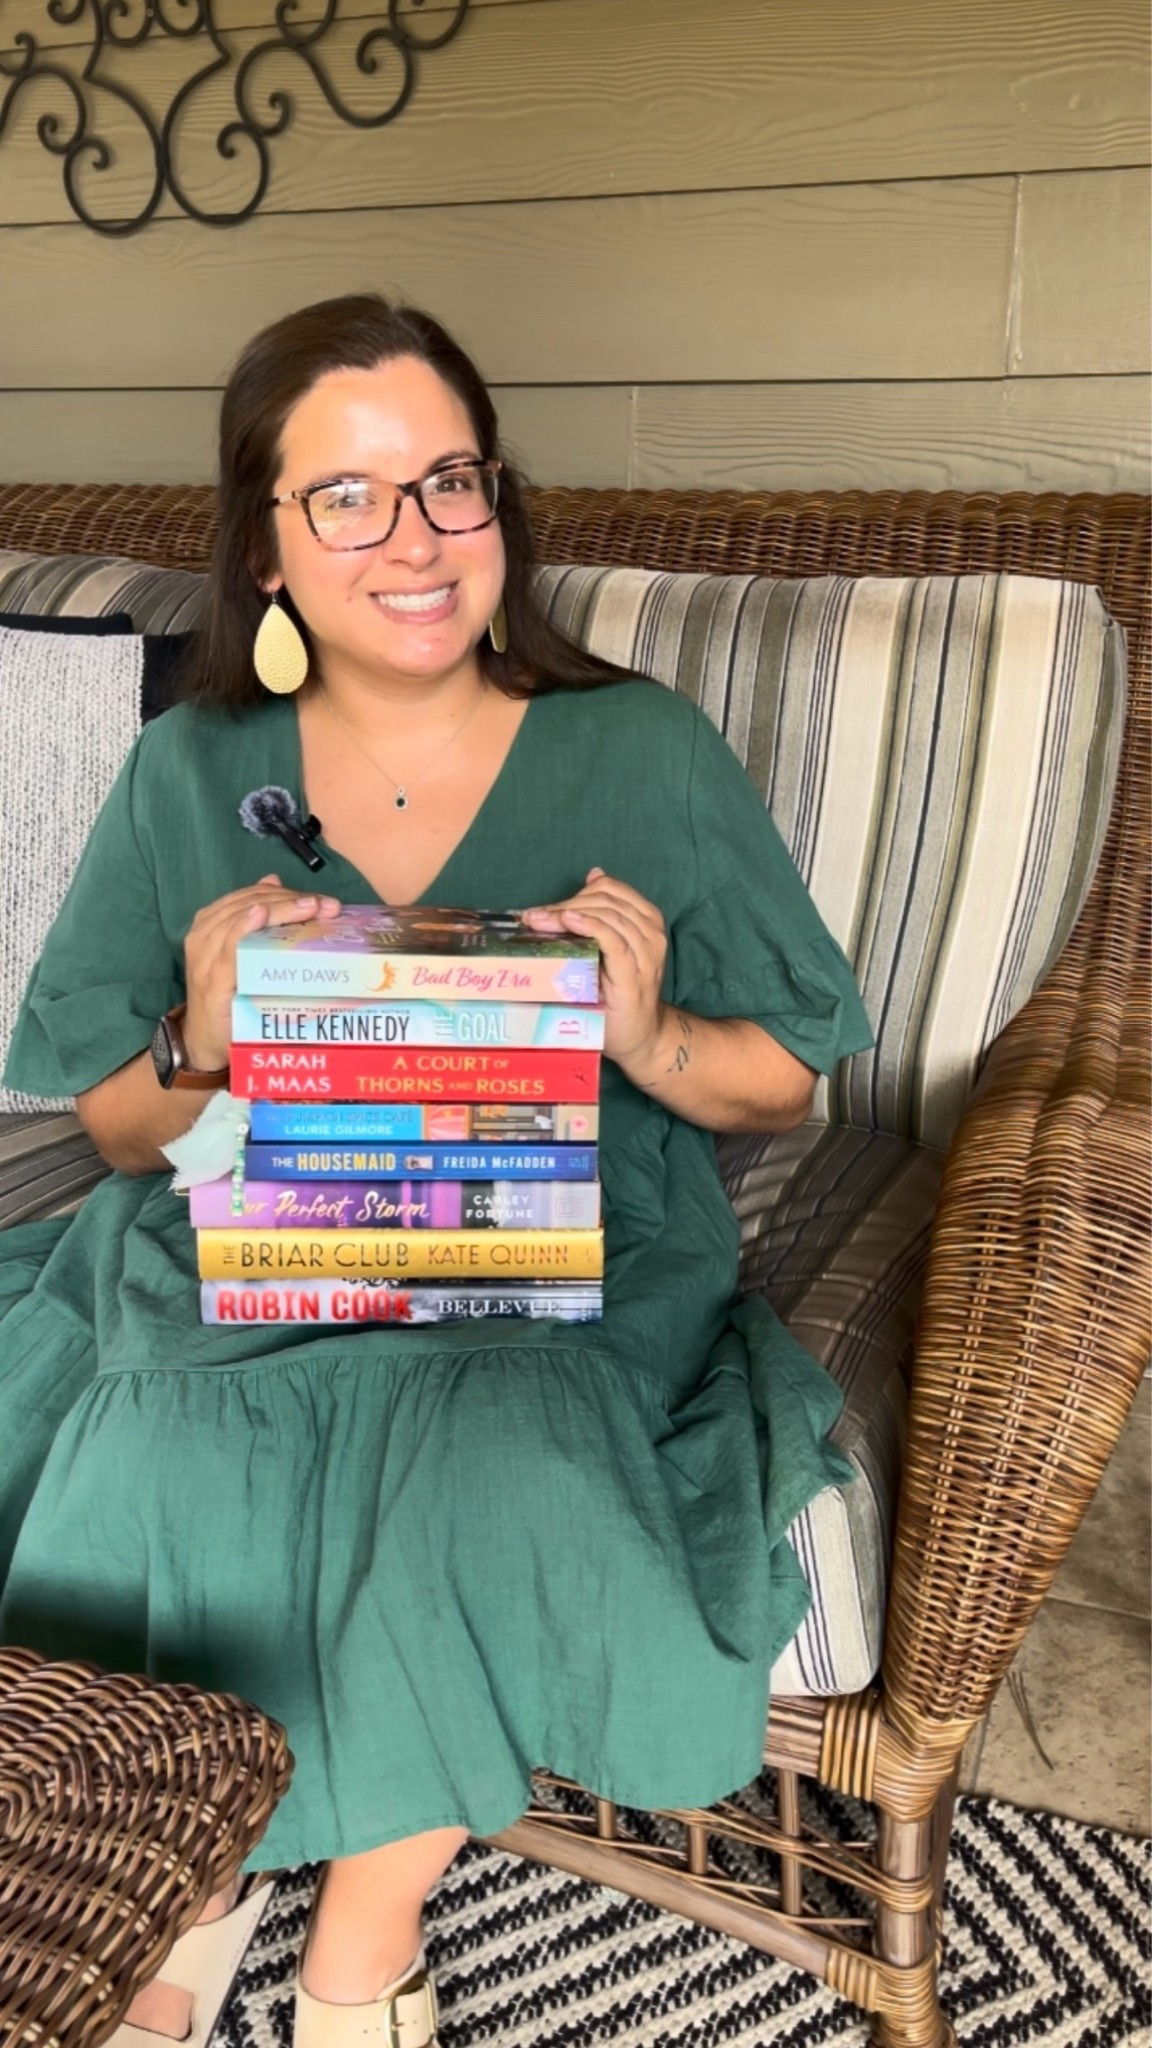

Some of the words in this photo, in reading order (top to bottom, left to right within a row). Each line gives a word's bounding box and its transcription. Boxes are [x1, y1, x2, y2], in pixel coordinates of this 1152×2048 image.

[260, 968, 298, 983] AMY
[302, 969, 350, 983] DAWS
[412, 966, 453, 986] Bad
[456, 967, 493, 992] Boy
[497, 969, 532, 988] Era
[261, 1014, 307, 1040] ELLE
[317, 1014, 410, 1042] KENNEDY
[434, 1012, 454, 1037] THE
[458, 1012, 510, 1042] GOAL
[251, 1053, 327, 1070] SARAH
[393, 1056, 408, 1070] A
[416, 1056, 490, 1071] COURT
[493, 1060, 509, 1069] OF
[247, 1076, 260, 1093] J.
[267, 1076, 331, 1093] MAAS
[356, 1076, 444, 1094] THORNS
[448, 1082, 473, 1091] AND
[476, 1079, 545, 1095] ROSES
[284, 1125, 331, 1135] LAURIE
[335, 1125, 394, 1135] GILMORE
[271, 1157, 294, 1168] THE
[297, 1152, 396, 1172] HOUSEMAID
[443, 1156, 487, 1169] FREIDA
[491, 1156, 556, 1169] McFADDEN
[274, 1190, 354, 1220] Perfect
[355, 1190, 430, 1222] Storm
[473, 1195, 530, 1206] CARLEY
[466, 1209, 534, 1219] FORTUNE
[223, 1244, 236, 1265] THE
[241, 1243, 324, 1267] BRIAR
[333, 1242, 410, 1267] CLUB
[428, 1244, 480, 1265] KATE
[490, 1244, 569, 1266] QUINN
[217, 1289, 321, 1322] ROBIN
[331, 1289, 415, 1322] COOK
[438, 1298, 561, 1316] BELLEVUE
